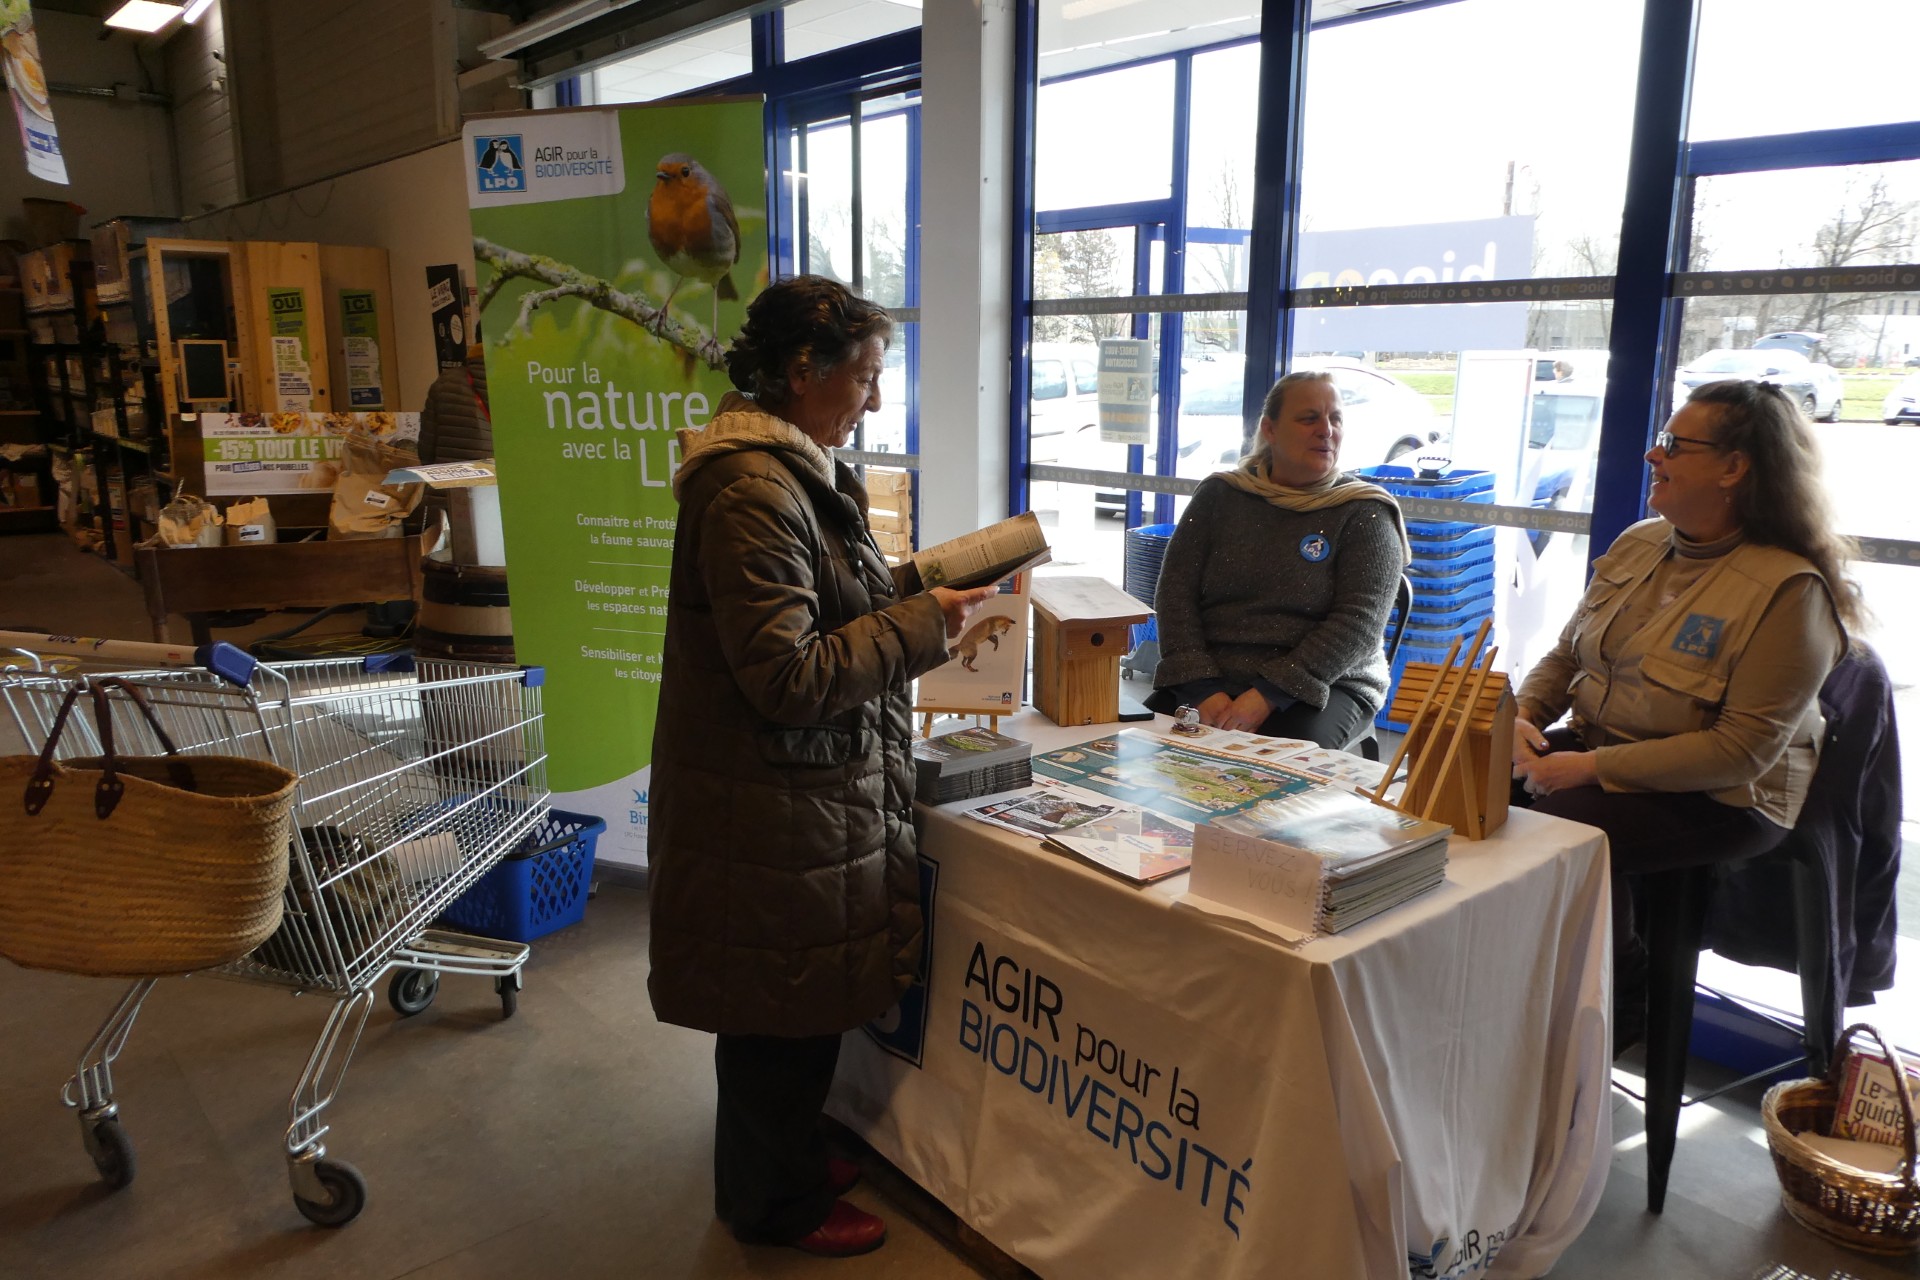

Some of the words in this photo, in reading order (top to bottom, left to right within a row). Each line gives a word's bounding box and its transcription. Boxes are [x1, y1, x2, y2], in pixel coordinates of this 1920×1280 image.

[535, 147, 563, 162] AGIR
[566, 149, 588, 163] pour
[590, 147, 598, 159] la
[535, 156, 613, 178] BIODIVERSITÉ
[484, 176, 518, 189] LPO
[273, 297, 303, 310] OUI
[344, 298, 374, 312] ICI
[527, 361, 576, 384] Pour
[582, 361, 601, 384] la
[543, 381, 710, 432] nature
[255, 439, 295, 459] TOUT
[300, 439, 320, 459] LE
[562, 442, 606, 460] avec
[613, 438, 632, 460] la
[633, 520, 643, 529] et
[645, 515, 677, 531] Proté
[590, 533, 599, 544] la
[600, 532, 633, 547] faune
[1303, 543, 1320, 558] LPO
[574, 579, 636, 597] Développer
[639, 588, 649, 597] et
[587, 600, 600, 610] les
[602, 602, 646, 615] espaces
[580, 645, 643, 662] Sensibiliser
[645, 654, 656, 664] et
[1678, 640, 1708, 655] LPO
[614, 668, 628, 679] les
[631, 669, 662, 684] citoye
[1247, 866, 1297, 899] VOUS
[965, 941, 1063, 1041] AGIR
[1076, 1023, 1160, 1097] pour
[1169, 1067, 1200, 1130] la
[1860, 1071, 1882, 1099] Le
[960, 999, 1252, 1240] BIODIVERSITÉ
[1854, 1099, 1905, 1130] guide
